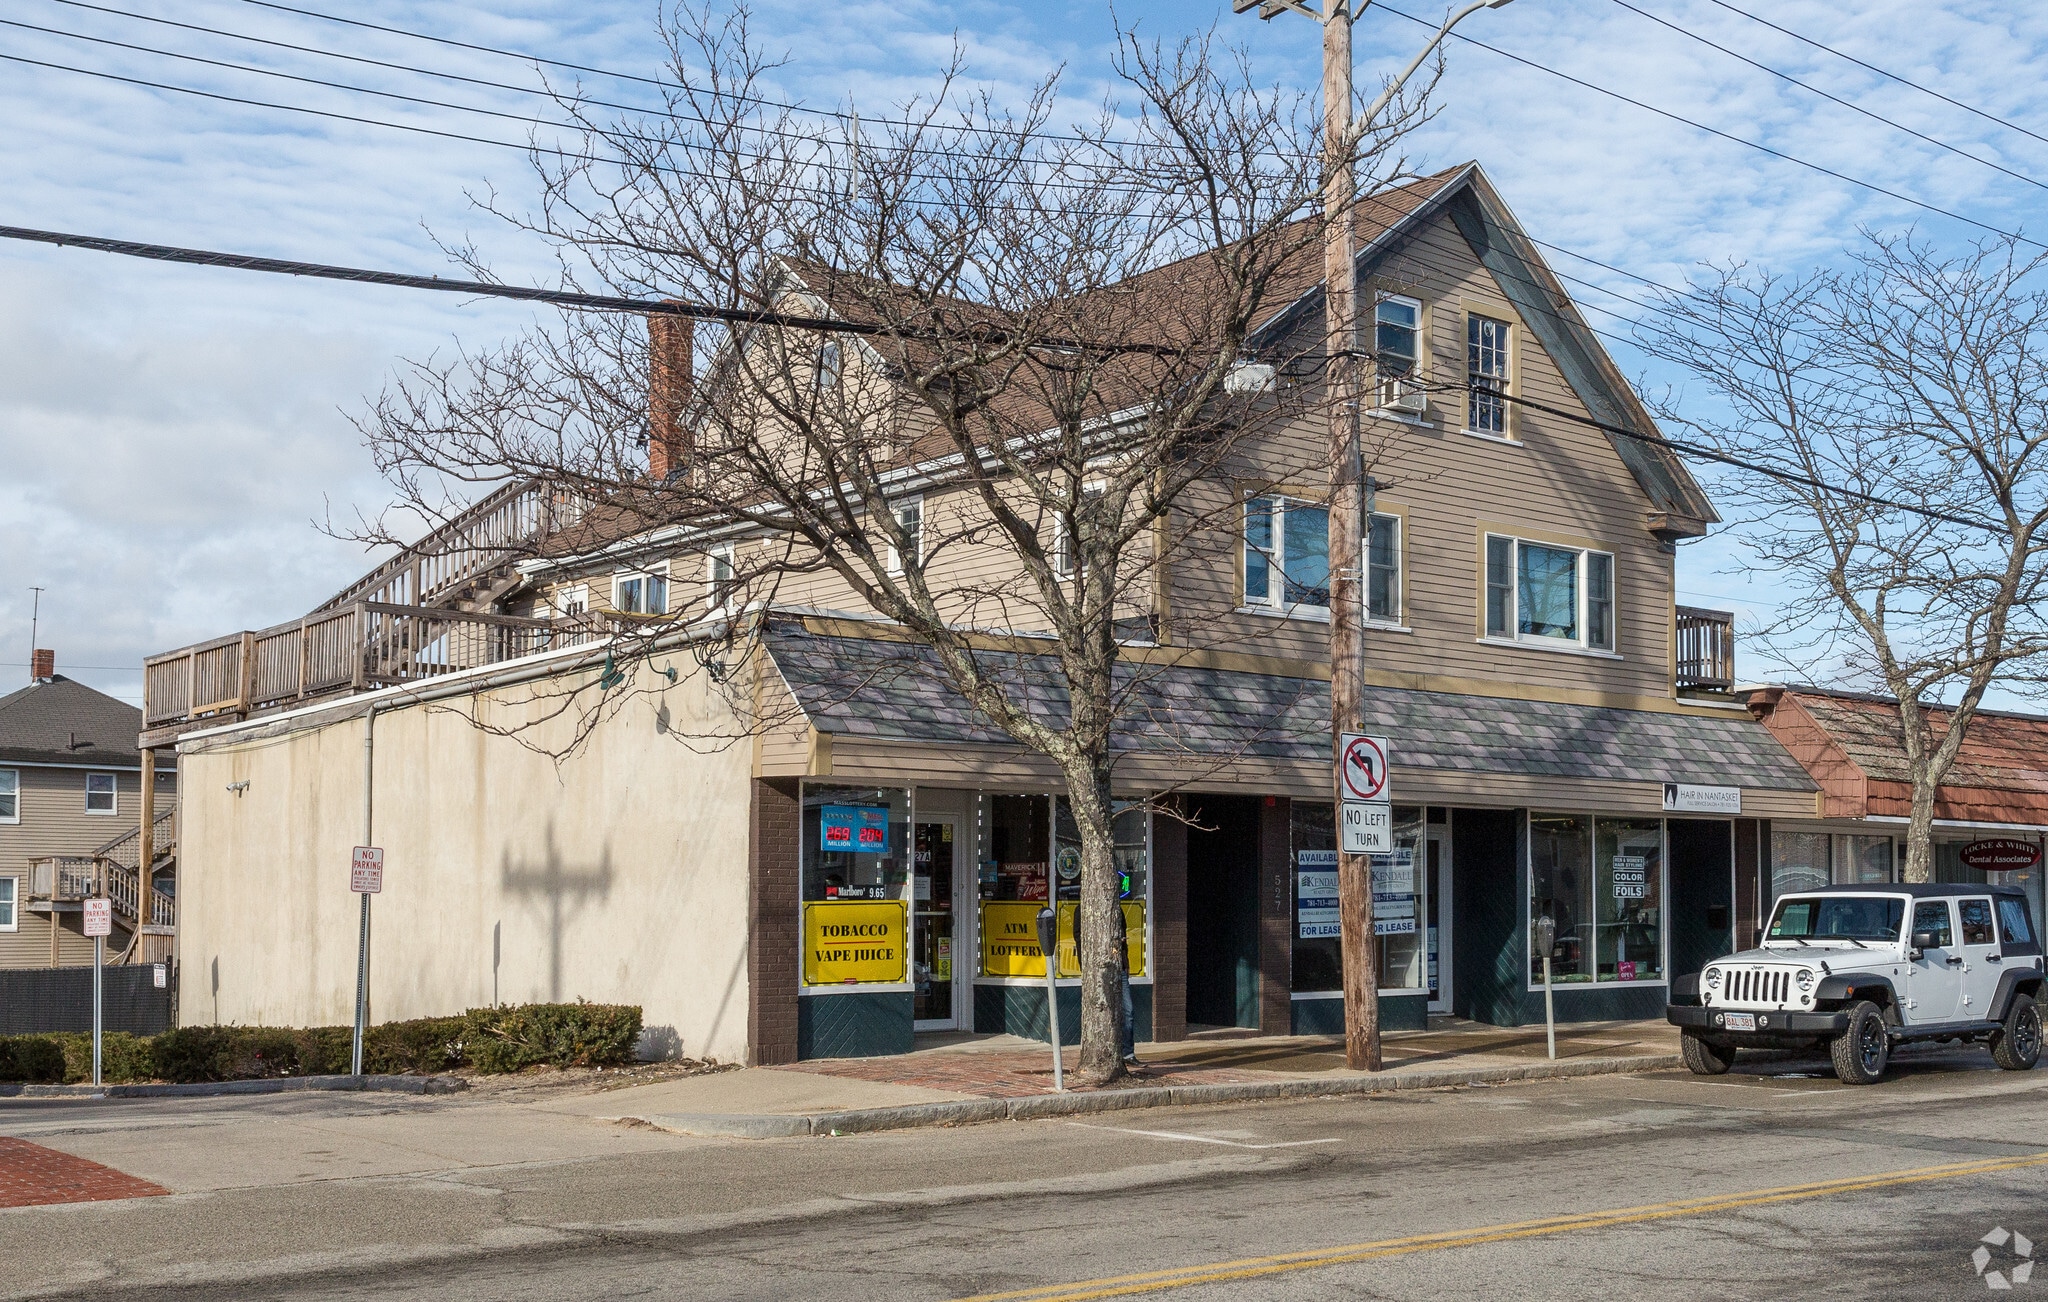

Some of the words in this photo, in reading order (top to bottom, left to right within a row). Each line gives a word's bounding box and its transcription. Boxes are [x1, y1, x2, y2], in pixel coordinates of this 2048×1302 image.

[1680, 790, 1696, 800] HAIR
[1697, 791, 1704, 800] IN
[1704, 792, 1738, 802] NANTASKET
[1346, 809, 1360, 825] NO
[1365, 811, 1387, 826] LEFT
[826, 826, 850, 840] 269
[859, 828, 883, 842] 204
[1355, 833, 1379, 846] TURN
[1964, 841, 1994, 855] LOCKE
[2006, 841, 2035, 855] WHITE
[362, 850, 374, 860] NO
[1300, 853, 1338, 862] AVAILABL
[1993, 855, 2032, 863] Associates
[354, 860, 381, 870] PARKING
[1005, 863, 1036, 871] MAVERICK
[1309, 876, 1338, 887] KENDAL
[1372, 871, 1412, 881] KENDALL
[1614, 873, 1643, 881] COLOR
[838, 884, 864, 897] Marlboro
[869, 887, 885, 898] 9.65
[1615, 887, 1642, 896] FOILS
[820, 924, 888, 937] TOBACCO
[1003, 923, 1028, 934] ATM
[1301, 926, 1317, 936] FOR
[1319, 926, 1341, 935] LEASE
[1374, 924, 1384, 933] OR
[1386, 922, 1413, 932] LEASE
[815, 949, 851, 962] VAPE
[854, 948, 894, 962] JUICE
[991, 945, 1042, 957] LOTTERY
[1741, 1017, 1754, 1027] 381
